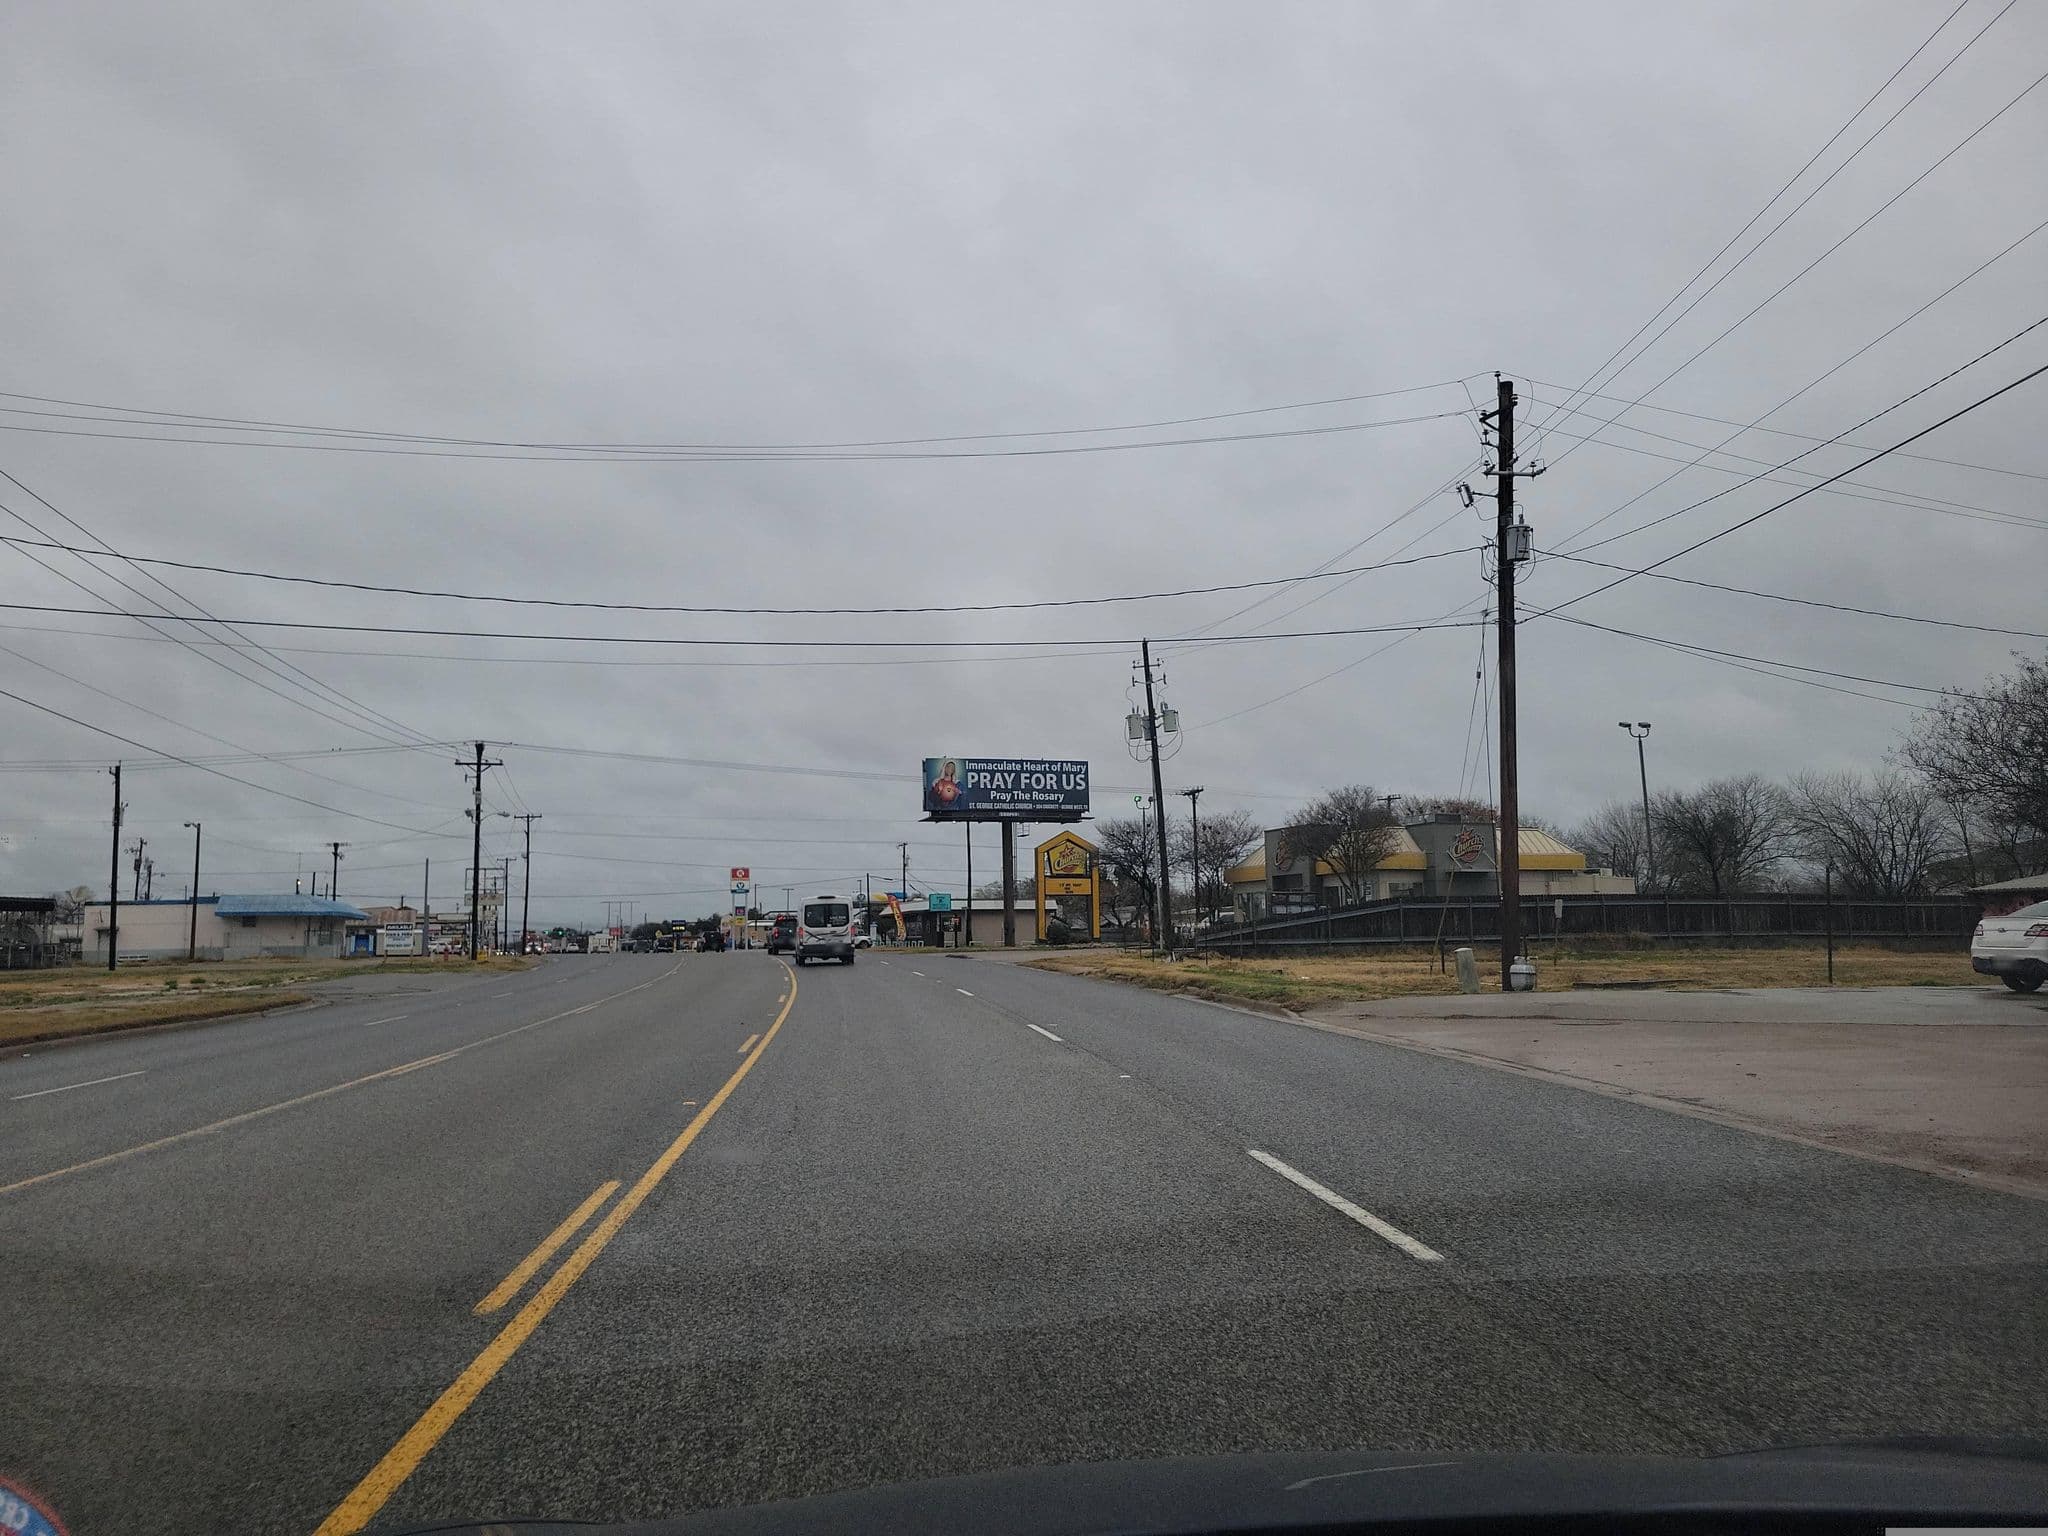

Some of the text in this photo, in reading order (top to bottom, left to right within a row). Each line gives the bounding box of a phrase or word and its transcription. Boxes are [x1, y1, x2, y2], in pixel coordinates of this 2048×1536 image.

[966, 760, 1087, 773] Immaculate Heart of Mary
[967, 772, 1086, 790] PRAY FOR US
[990, 791, 1064, 803] Pray The Rosary
